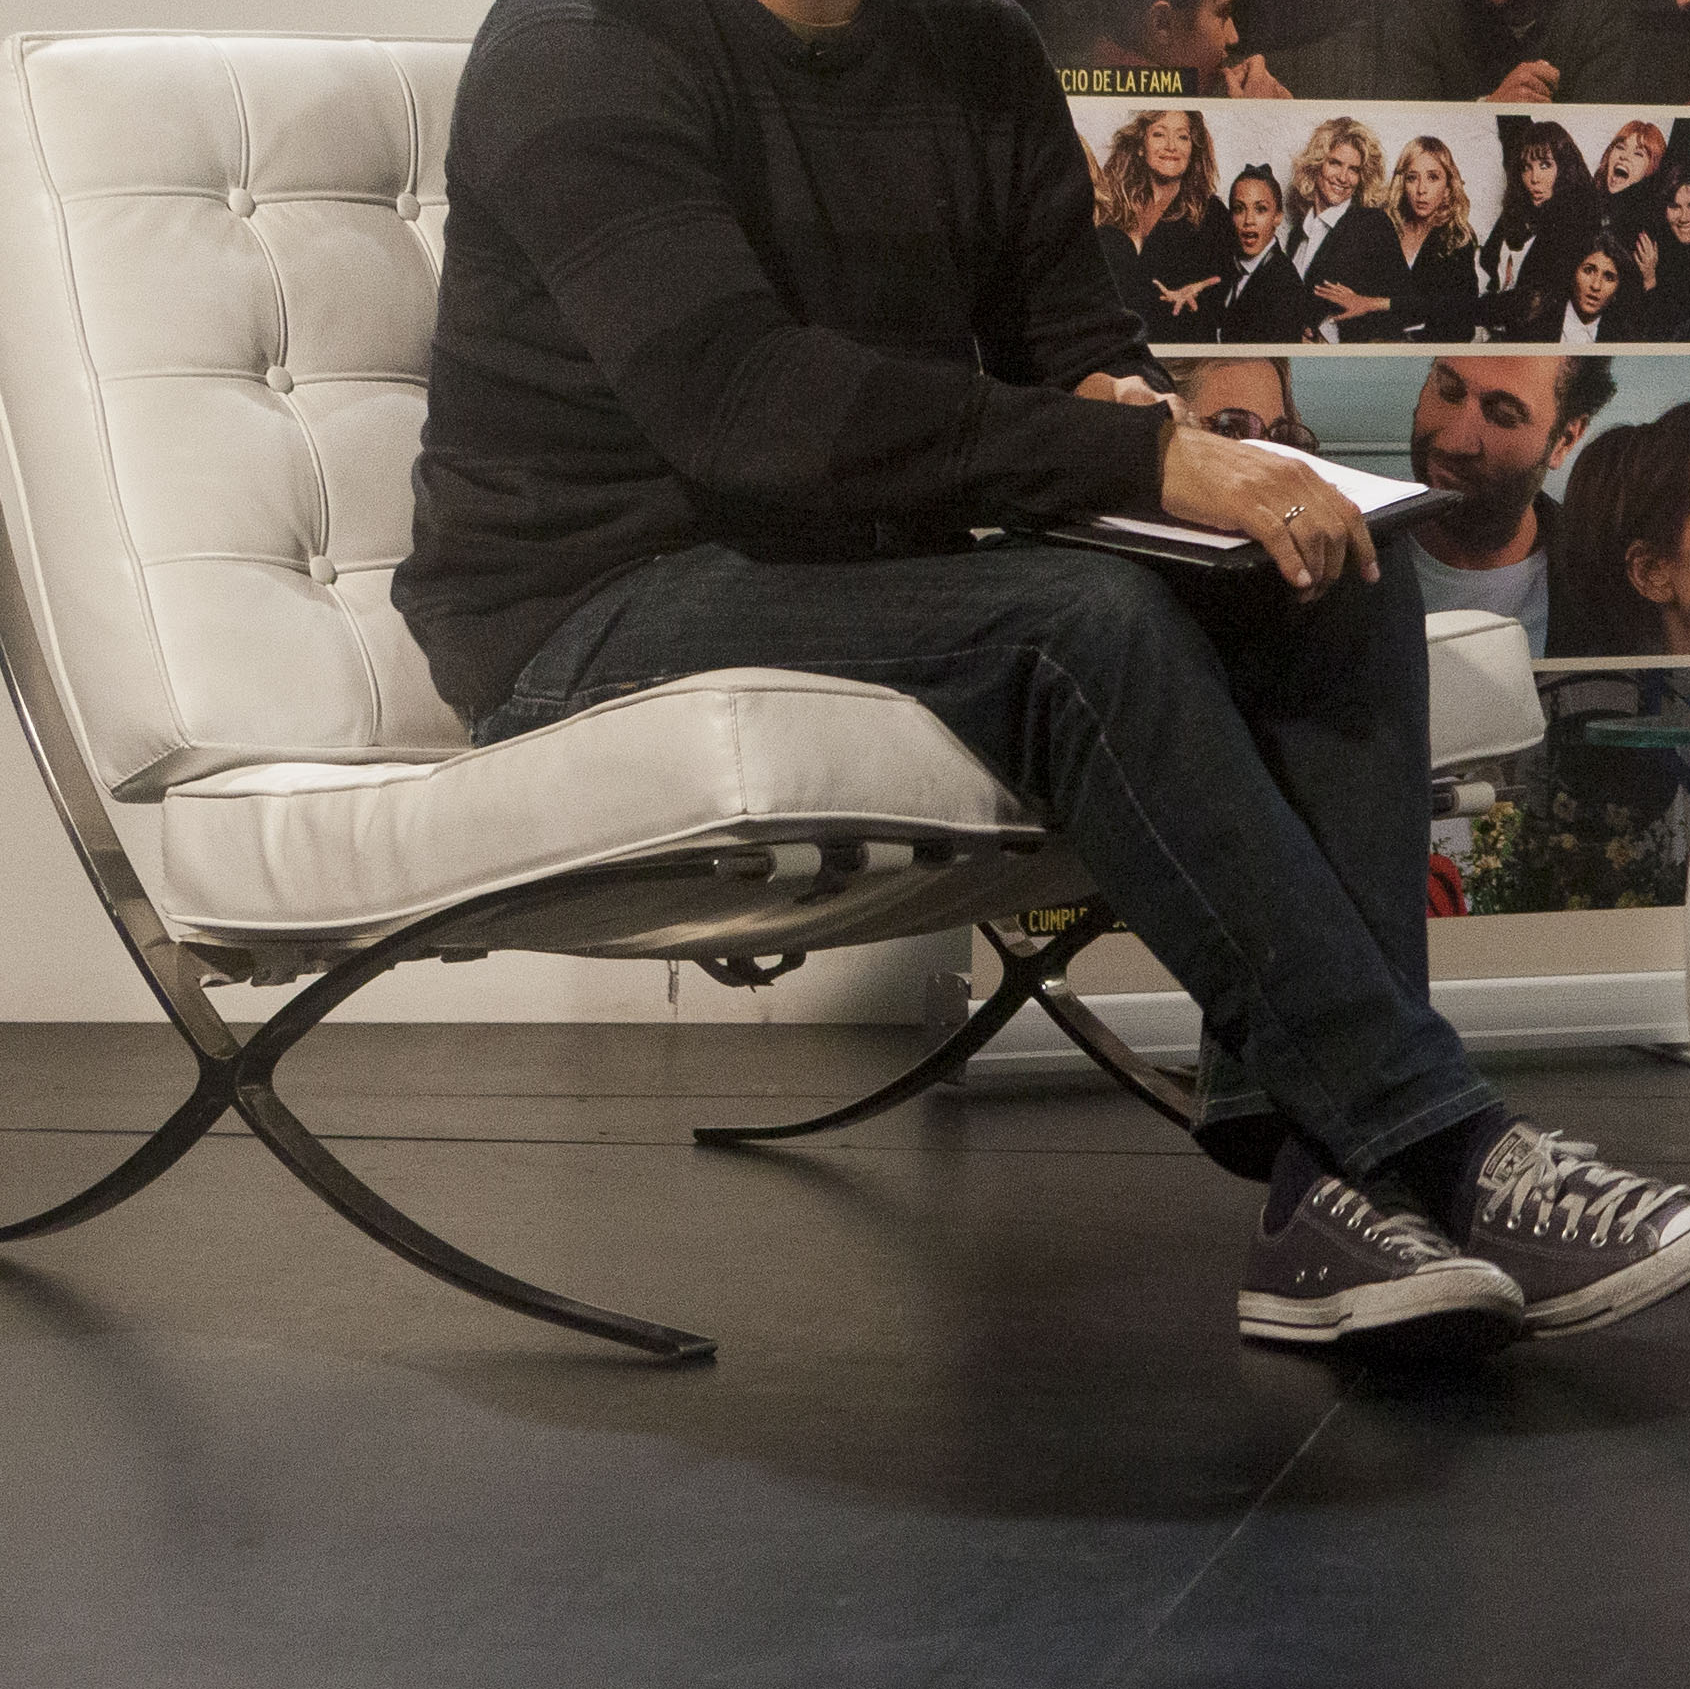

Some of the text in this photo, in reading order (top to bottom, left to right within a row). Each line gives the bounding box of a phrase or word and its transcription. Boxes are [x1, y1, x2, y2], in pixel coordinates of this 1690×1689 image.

[1057, 69, 1183, 93] CIO DE LA FAMA
